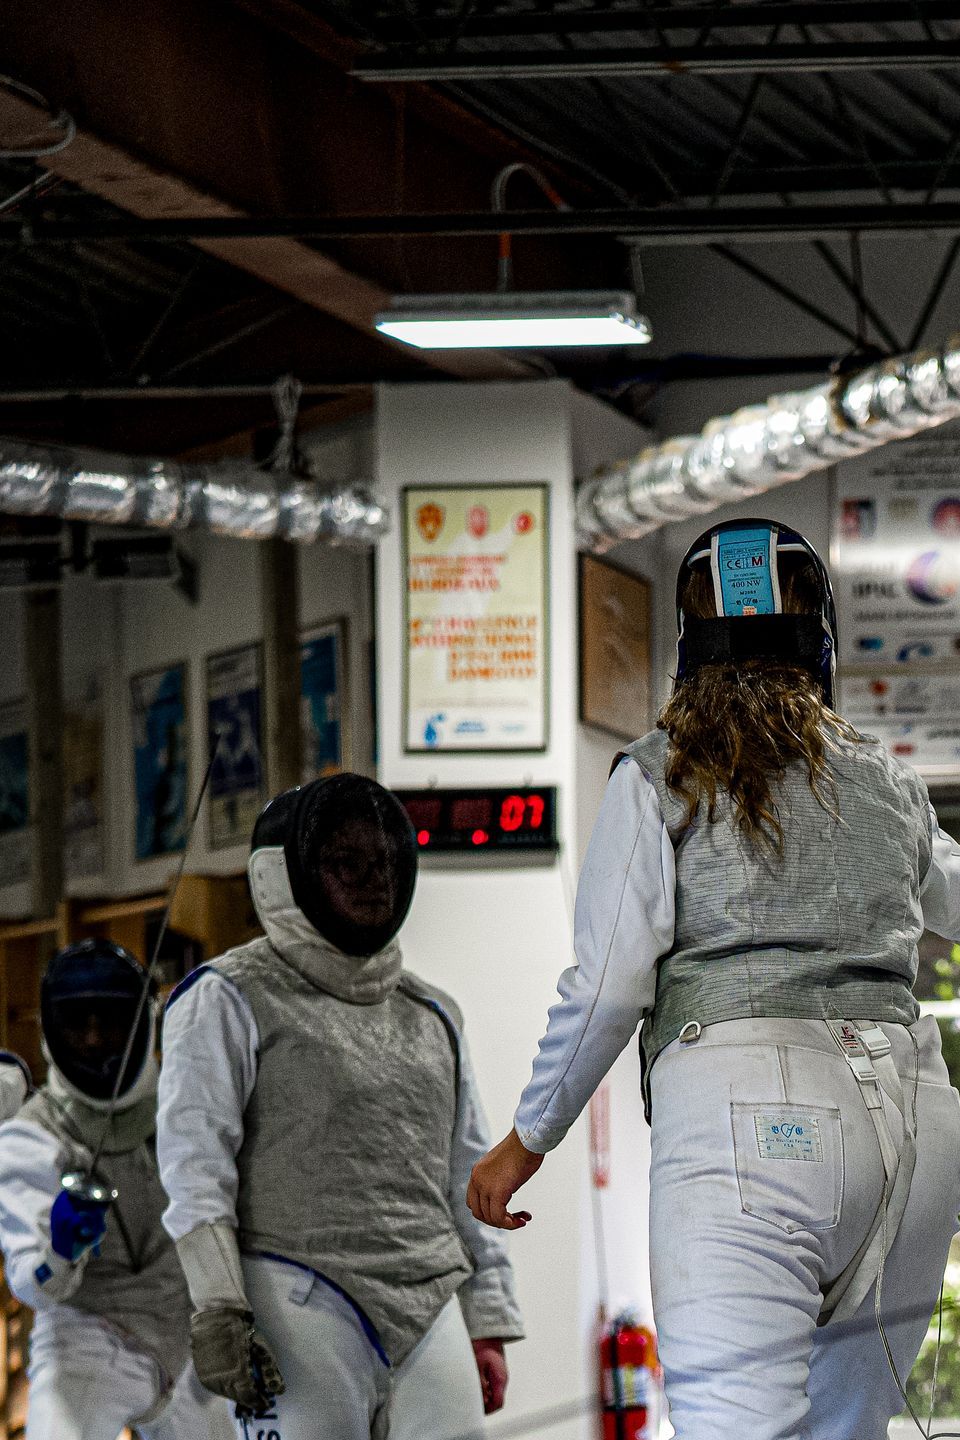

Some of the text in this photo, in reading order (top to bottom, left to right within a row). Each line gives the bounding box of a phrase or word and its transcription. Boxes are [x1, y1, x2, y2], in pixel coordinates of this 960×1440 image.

[752, 555, 763, 566] M
[732, 578, 761, 588] 400 NW
